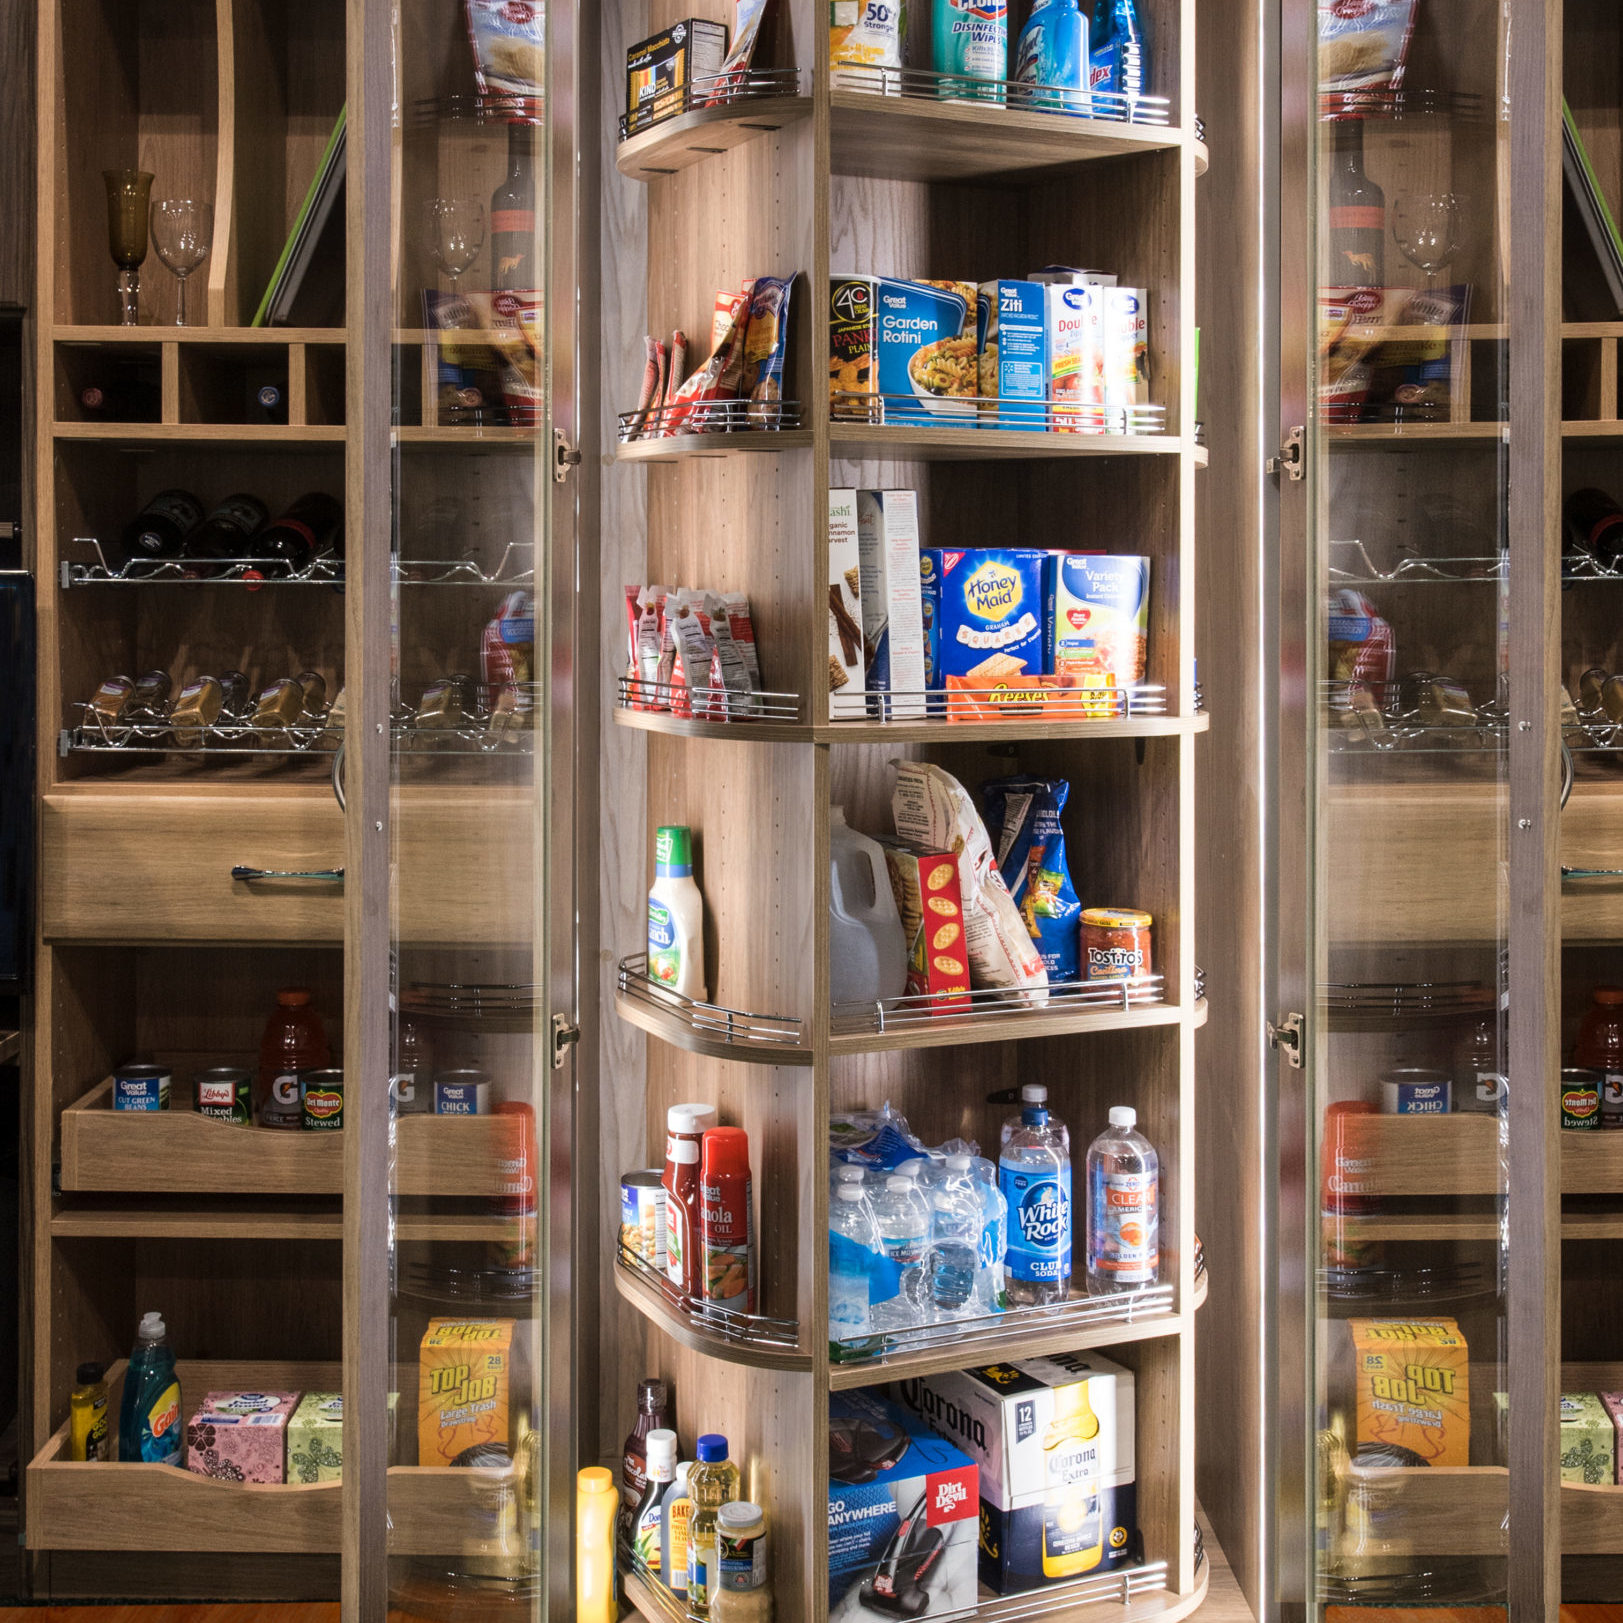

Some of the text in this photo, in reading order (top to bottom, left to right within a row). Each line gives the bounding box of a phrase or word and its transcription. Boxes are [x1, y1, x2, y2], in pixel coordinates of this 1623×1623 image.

[640, 83, 656, 97] KIND
[836, 287, 868, 319] 4C
[883, 295, 906, 304] Great
[1000, 298, 1023, 312] Ziti
[883, 315, 938, 331] Garden
[883, 330, 921, 344] Rotini
[830, 505, 850, 517] ashi
[968, 575, 1017, 598] Honey
[1092, 581, 1119, 593] Pack
[976, 590, 1012, 611] Maid
[985, 620, 1010, 631] GRAHAM
[120, 1081, 147, 1091] Great
[126, 1088, 147, 1096] Value
[203, 1087, 230, 1099] Libby's
[272, 1074, 299, 1105] G
[443, 1087, 464, 1096] Great
[317, 1098, 340, 1107] Monte
[441, 1101, 470, 1112] CHICK
[201, 1106, 232, 1117] Mixed
[305, 1116, 340, 1127] Stewed
[1018, 1200, 1068, 1230] White
[714, 1224, 733, 1233] OIL
[1026, 1216, 1067, 1241] Rock
[488, 1356, 501, 1364] 28
[430, 1365, 470, 1394] TOP
[453, 1375, 497, 1406] JOB
[440, 1400, 496, 1421] Large Trash
[1018, 1406, 1032, 1423] 12
[937, 1481, 963, 1498] Dirt
[935, 1487, 968, 1507] Devil
[828, 1500, 845, 1514] GO
[828, 1501, 897, 1526] ANYWHERE
